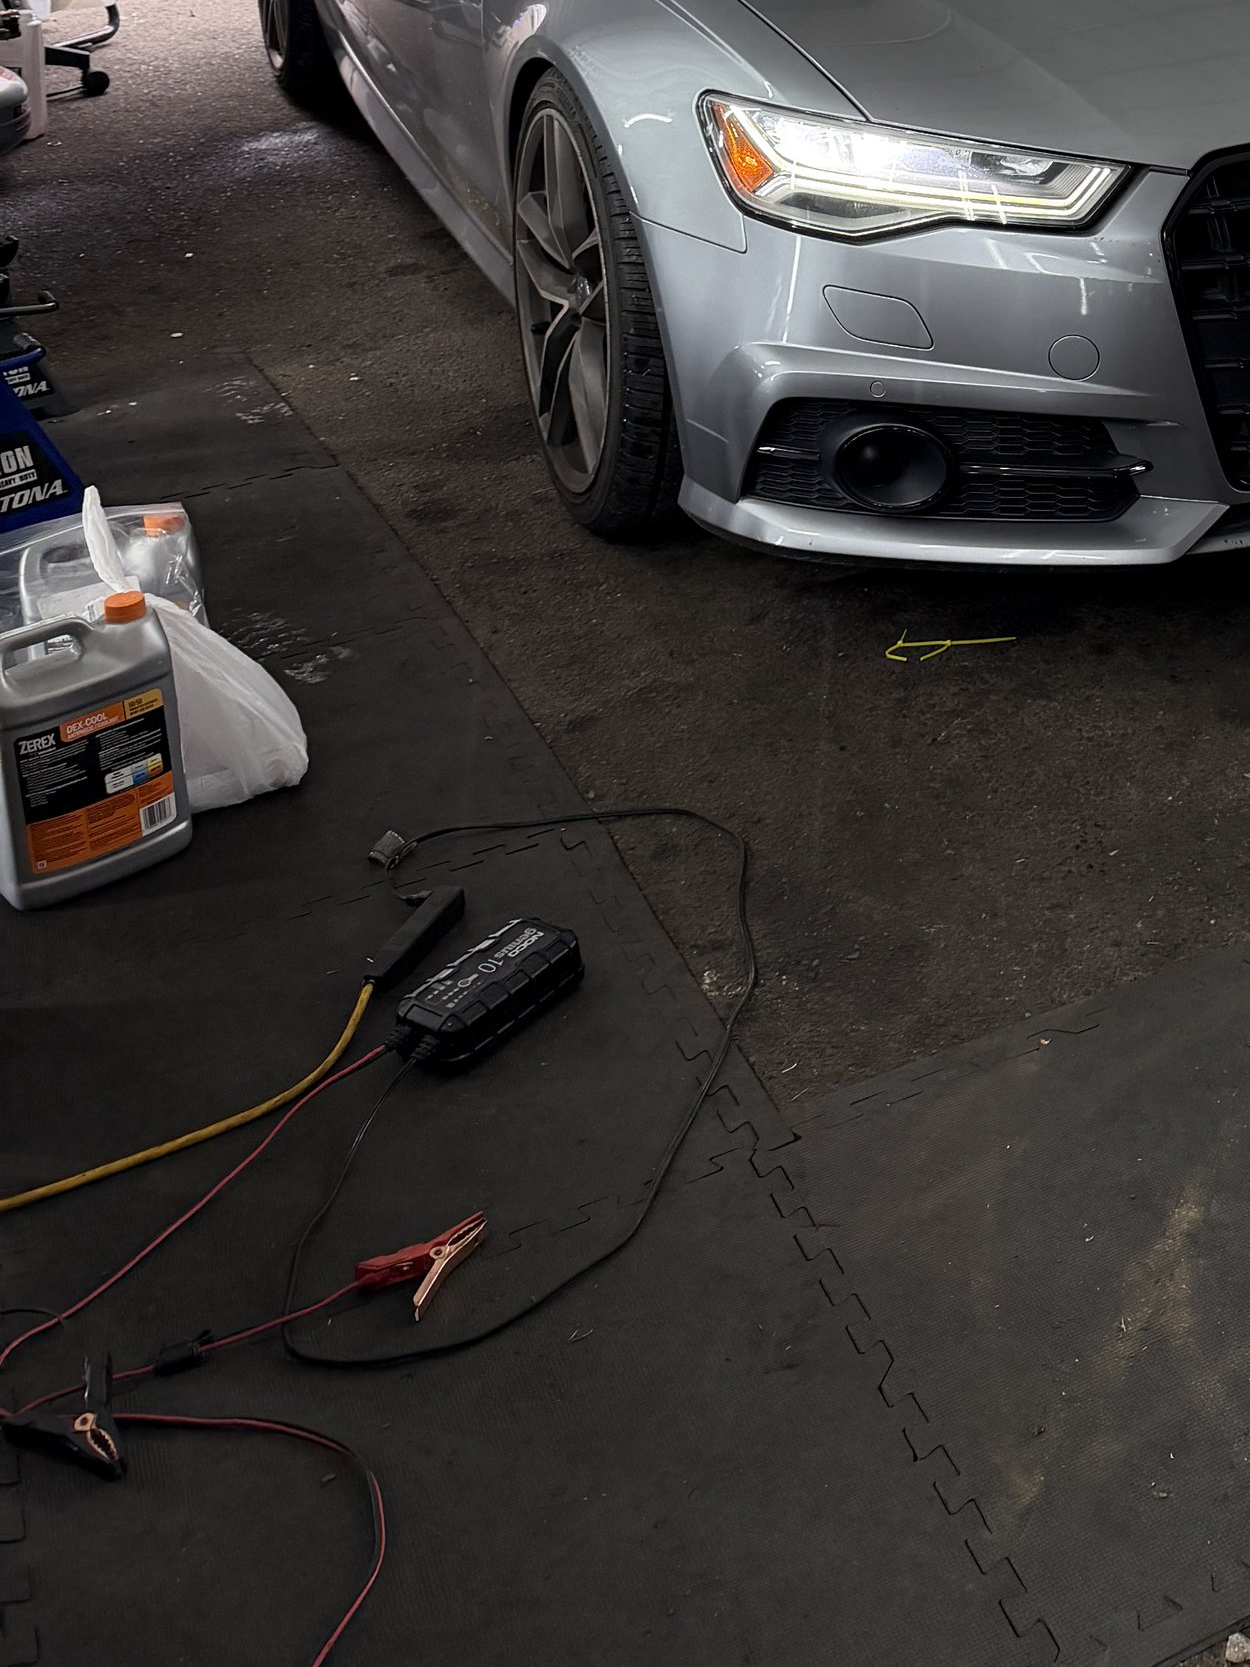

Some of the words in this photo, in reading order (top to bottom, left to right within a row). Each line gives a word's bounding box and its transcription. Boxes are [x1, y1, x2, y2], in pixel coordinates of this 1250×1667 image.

[0, 445, 34, 475] ON
[66, 712, 108, 734] DEX-COOL
[18, 733, 57, 755] ZEREX
[478, 958, 504, 973] 10
